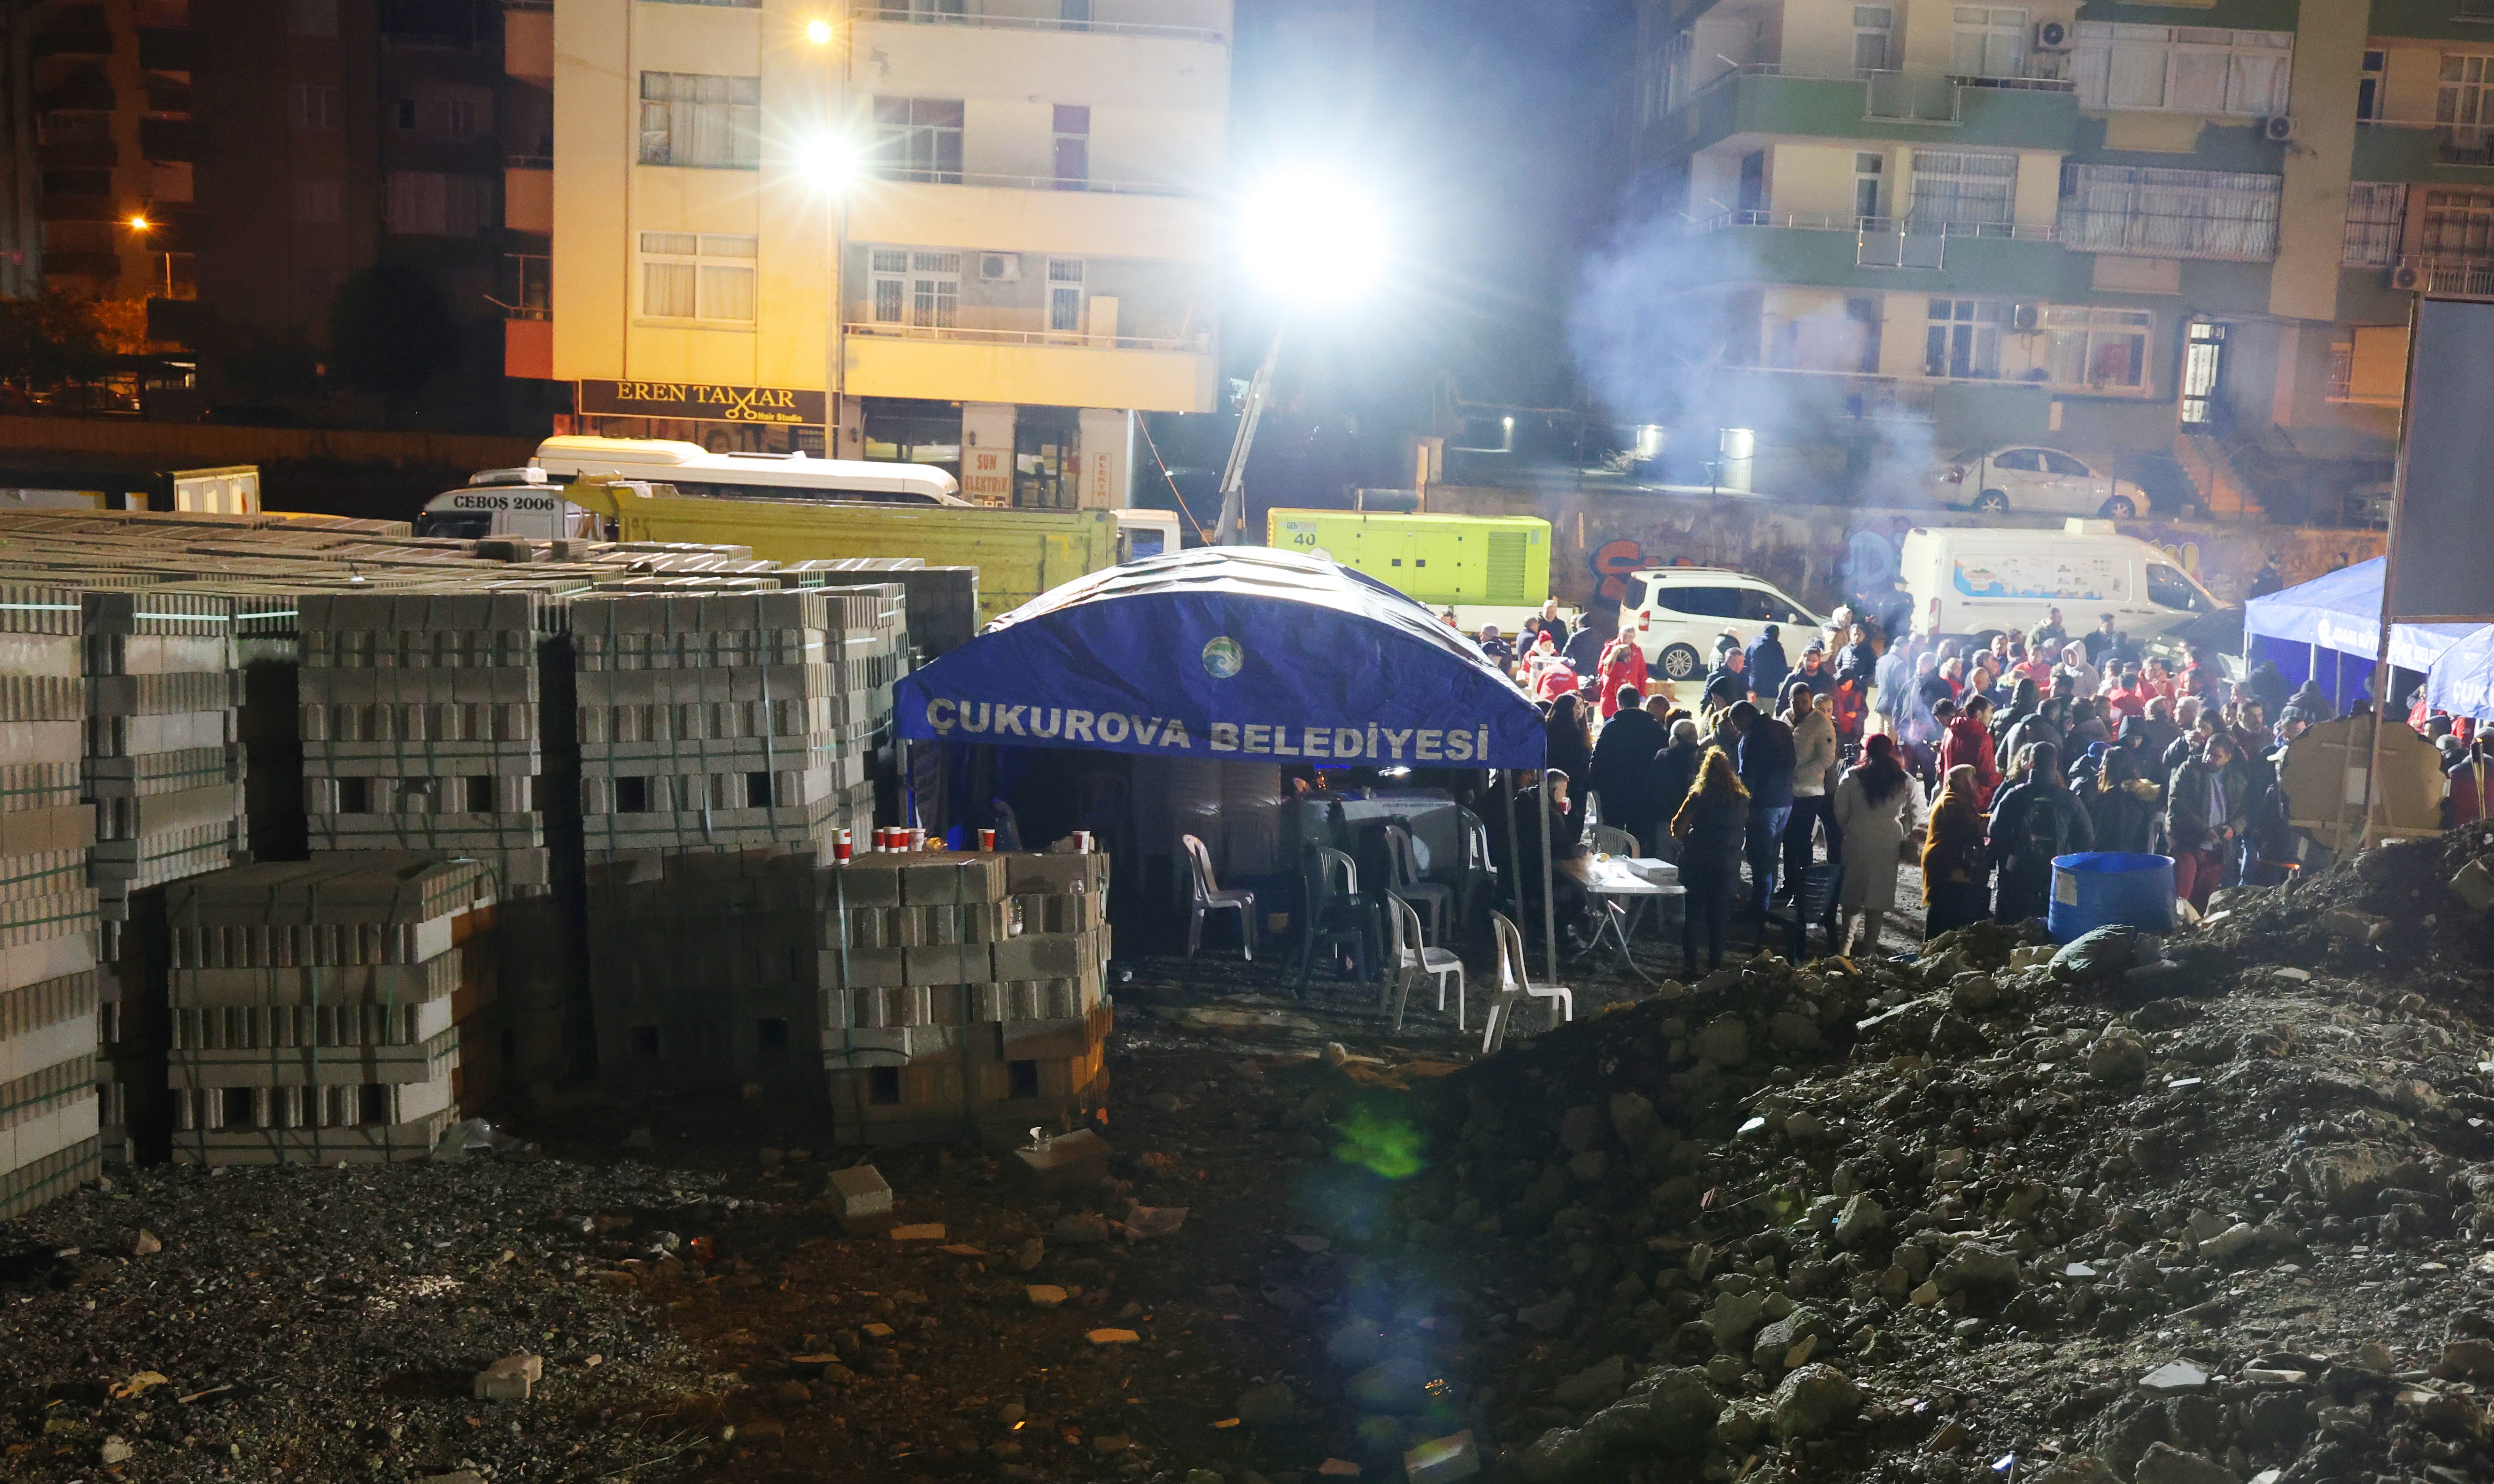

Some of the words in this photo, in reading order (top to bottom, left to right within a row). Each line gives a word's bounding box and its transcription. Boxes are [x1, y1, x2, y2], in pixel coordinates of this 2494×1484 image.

[617, 382, 686, 402] EREN
[693, 385, 796, 409] TAMAR
[758, 412, 775, 421] Hair
[977, 453, 996, 470] SUN
[454, 495, 508, 510] CEBOS
[513, 497, 554, 510] 2006
[1293, 533, 1316, 545] 40
[926, 698, 1191, 749] ÇUKUROVA
[1210, 722, 1489, 761] BELEDİYESİ
